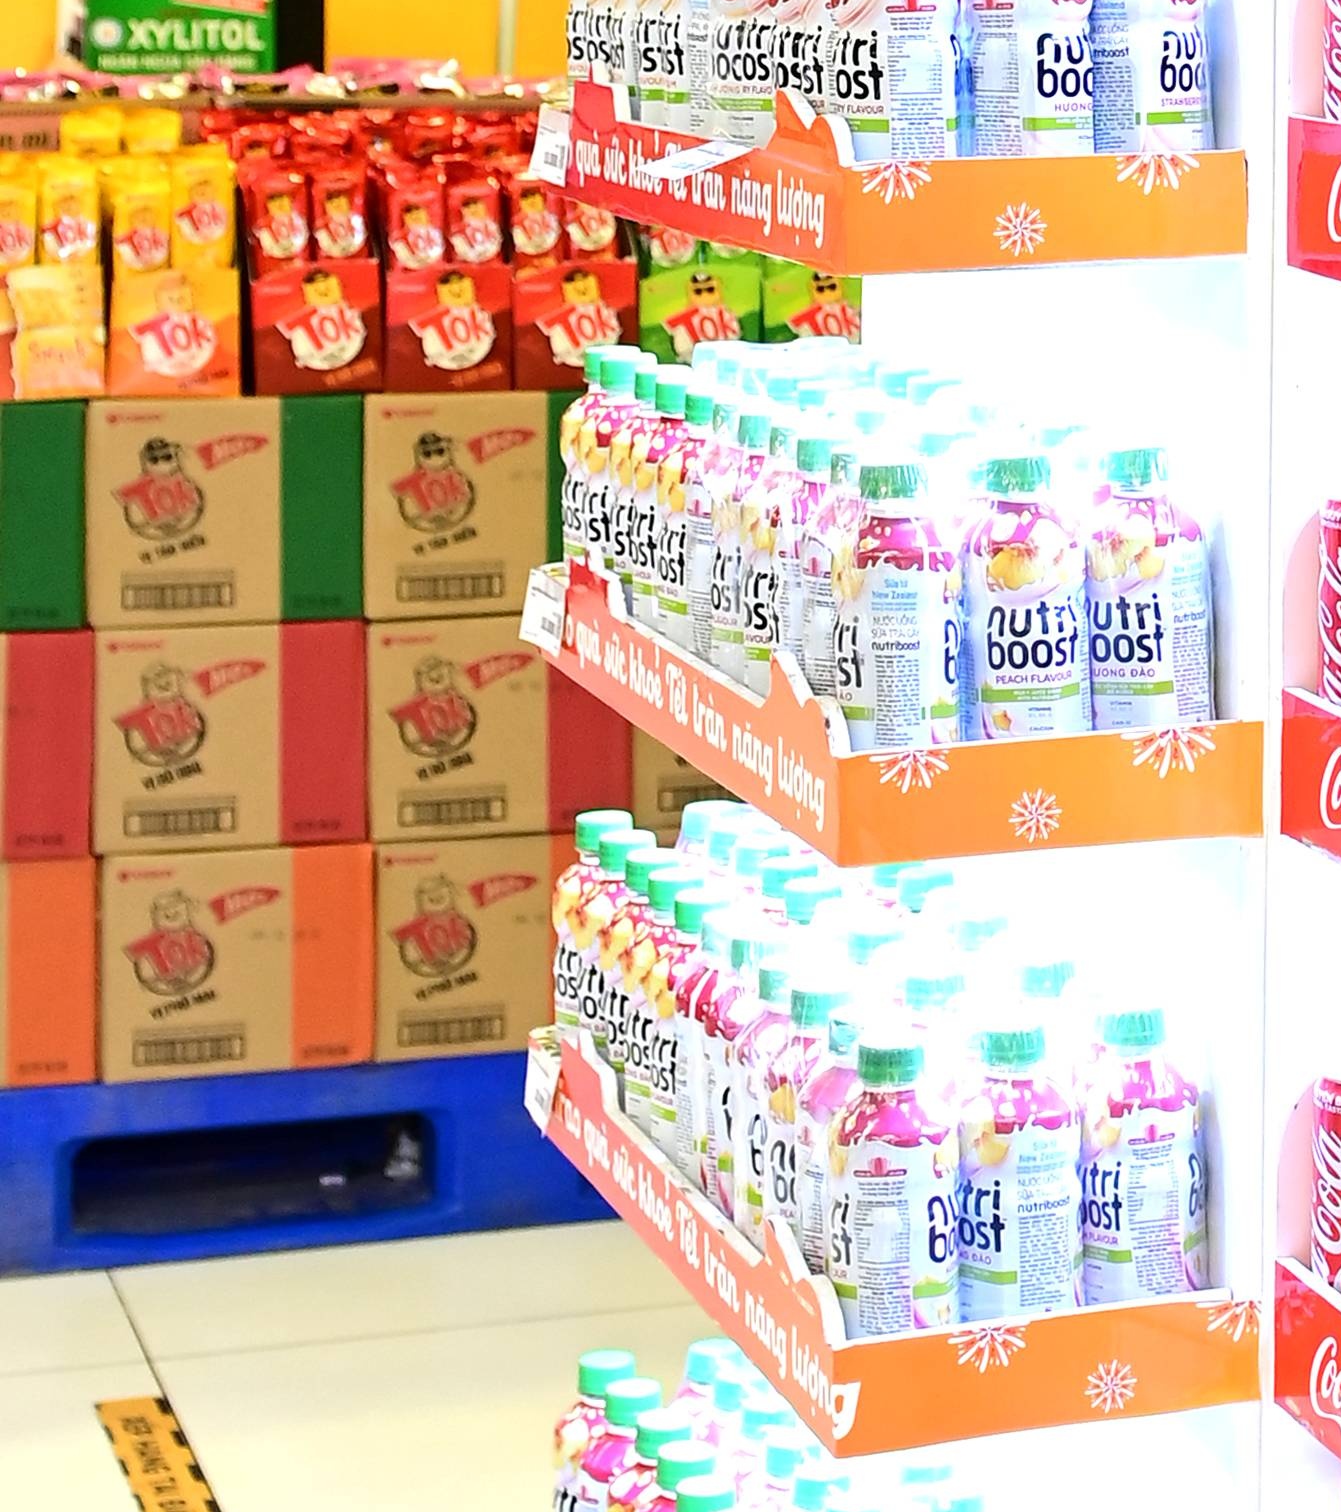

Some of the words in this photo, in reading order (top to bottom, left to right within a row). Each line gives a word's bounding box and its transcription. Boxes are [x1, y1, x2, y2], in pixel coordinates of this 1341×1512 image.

[127, 17, 263, 53] XYLITOL
[731, 169, 772, 236] năng
[777, 168, 825, 248] lượng
[987, 595, 1077, 638] nutri
[987, 626, 1079, 670] boost
[995, 674, 1028, 685] PEACH
[1031, 670, 1072, 683] FLAVOUR
[576, 620, 601, 669] quà
[604, 632, 627, 685] sức
[665, 661, 688, 726] Tết
[693, 684, 727, 753] tràn
[732, 722, 773, 797] năng
[778, 736, 825, 832] lượng
[612, 1143, 637, 1199] sức
[675, 1202, 701, 1270] Tết
[703, 1232, 740, 1313] tràn
[745, 1289, 787, 1379] năng
[791, 1325, 861, 1440] lượng
